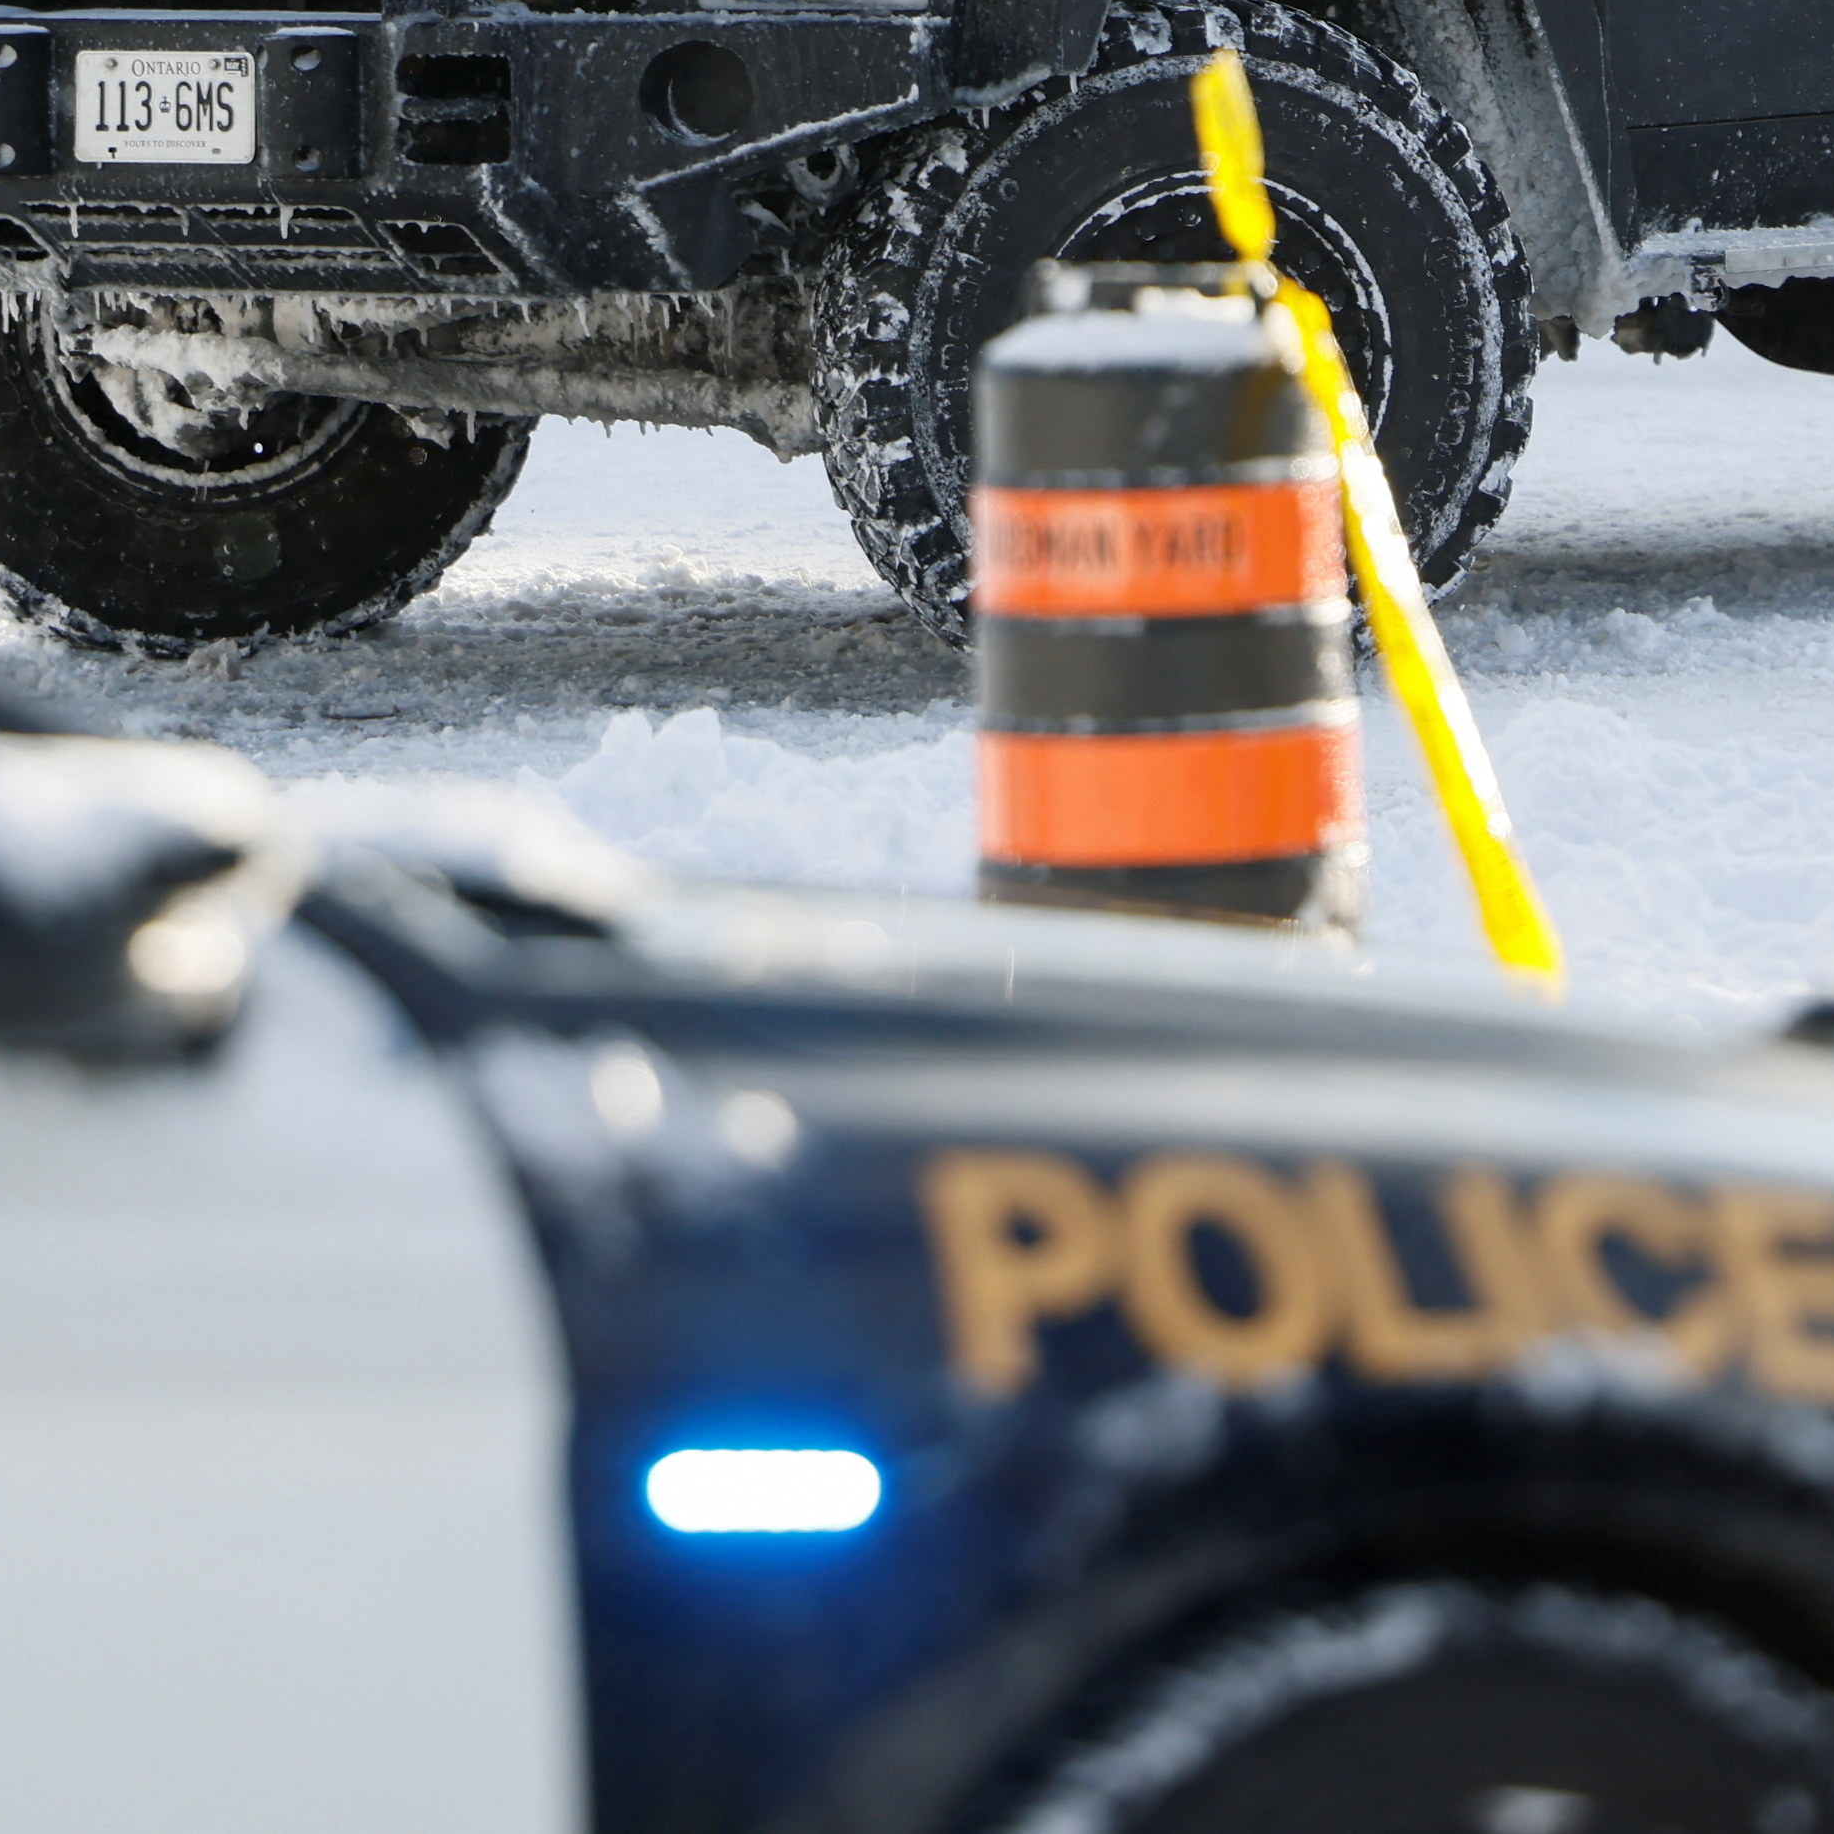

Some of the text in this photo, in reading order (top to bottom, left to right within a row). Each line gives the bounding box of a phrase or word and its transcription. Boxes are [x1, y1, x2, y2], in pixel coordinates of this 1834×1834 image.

[95, 80, 235, 133] 113 6MS
[124, 140, 207, 149] YOURS TO DISCOVER
